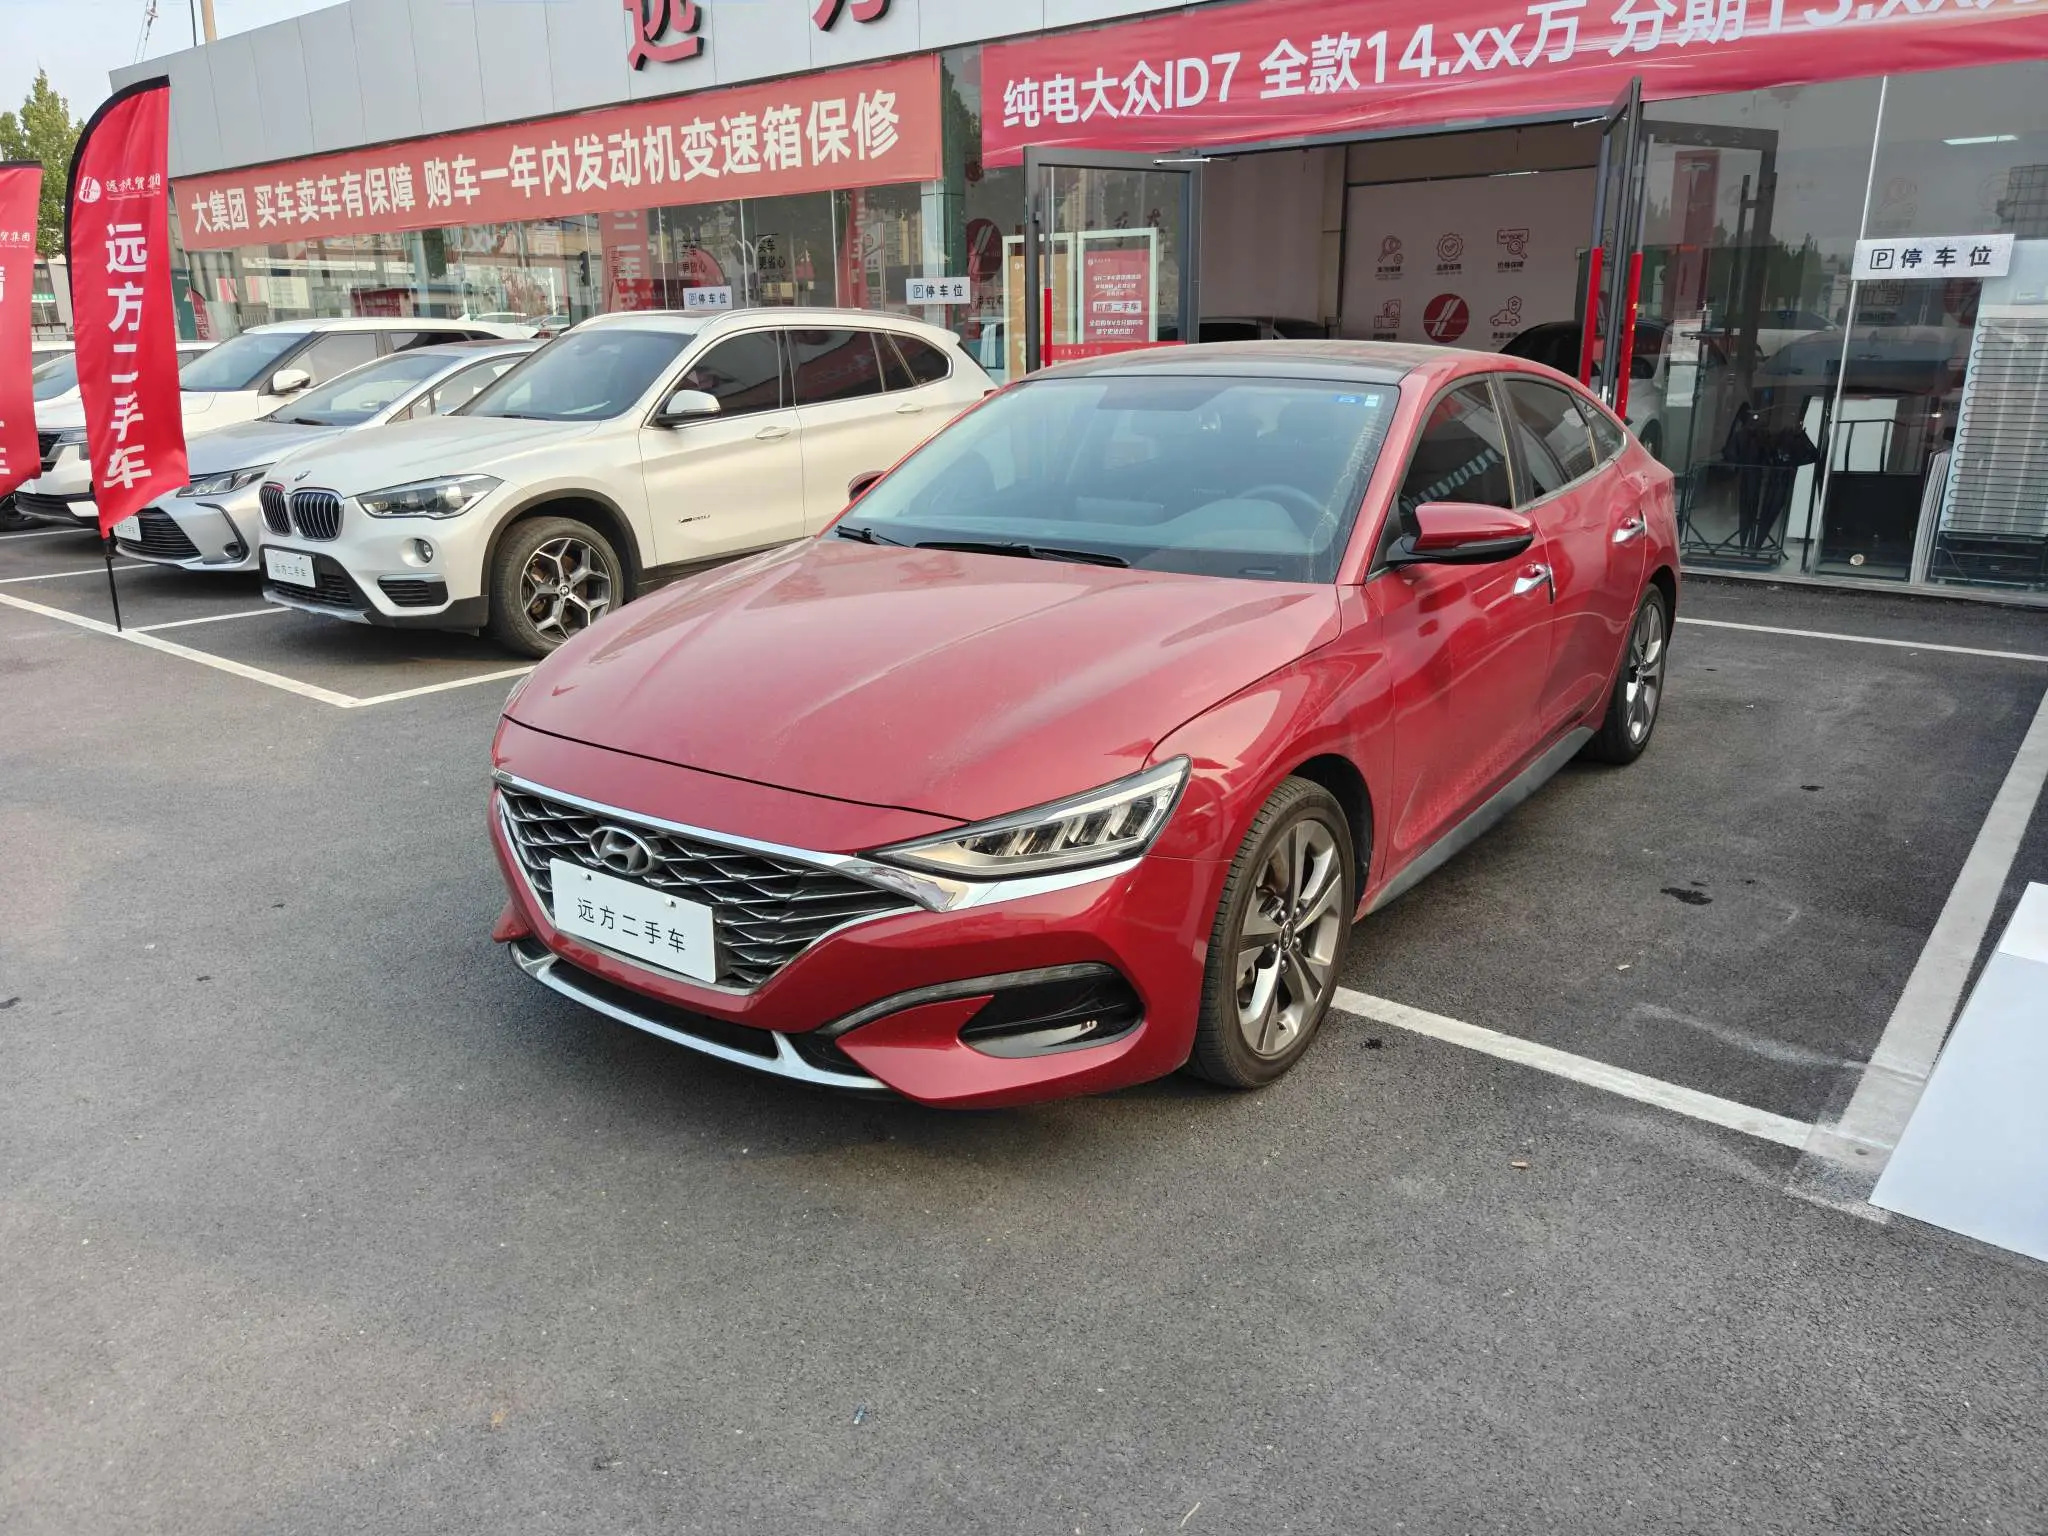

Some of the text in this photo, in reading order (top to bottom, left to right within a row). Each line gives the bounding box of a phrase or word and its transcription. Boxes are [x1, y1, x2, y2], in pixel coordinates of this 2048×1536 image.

[1003, 51, 1240, 127] 纯电大众ID7
[1260, 3, 1583, 99] 全款14.xx万
[192, 89, 900, 234] 大集团 买车卖车有保障 购车一年内发动机变速箱保修
[1900, 246, 1993, 268] 停车位
[698, 291, 727, 305] 停车位
[926, 284, 963, 297] 停车位
[104, 223, 152, 489] 远方二手车
[576, 896, 686, 953] 远方二手车
